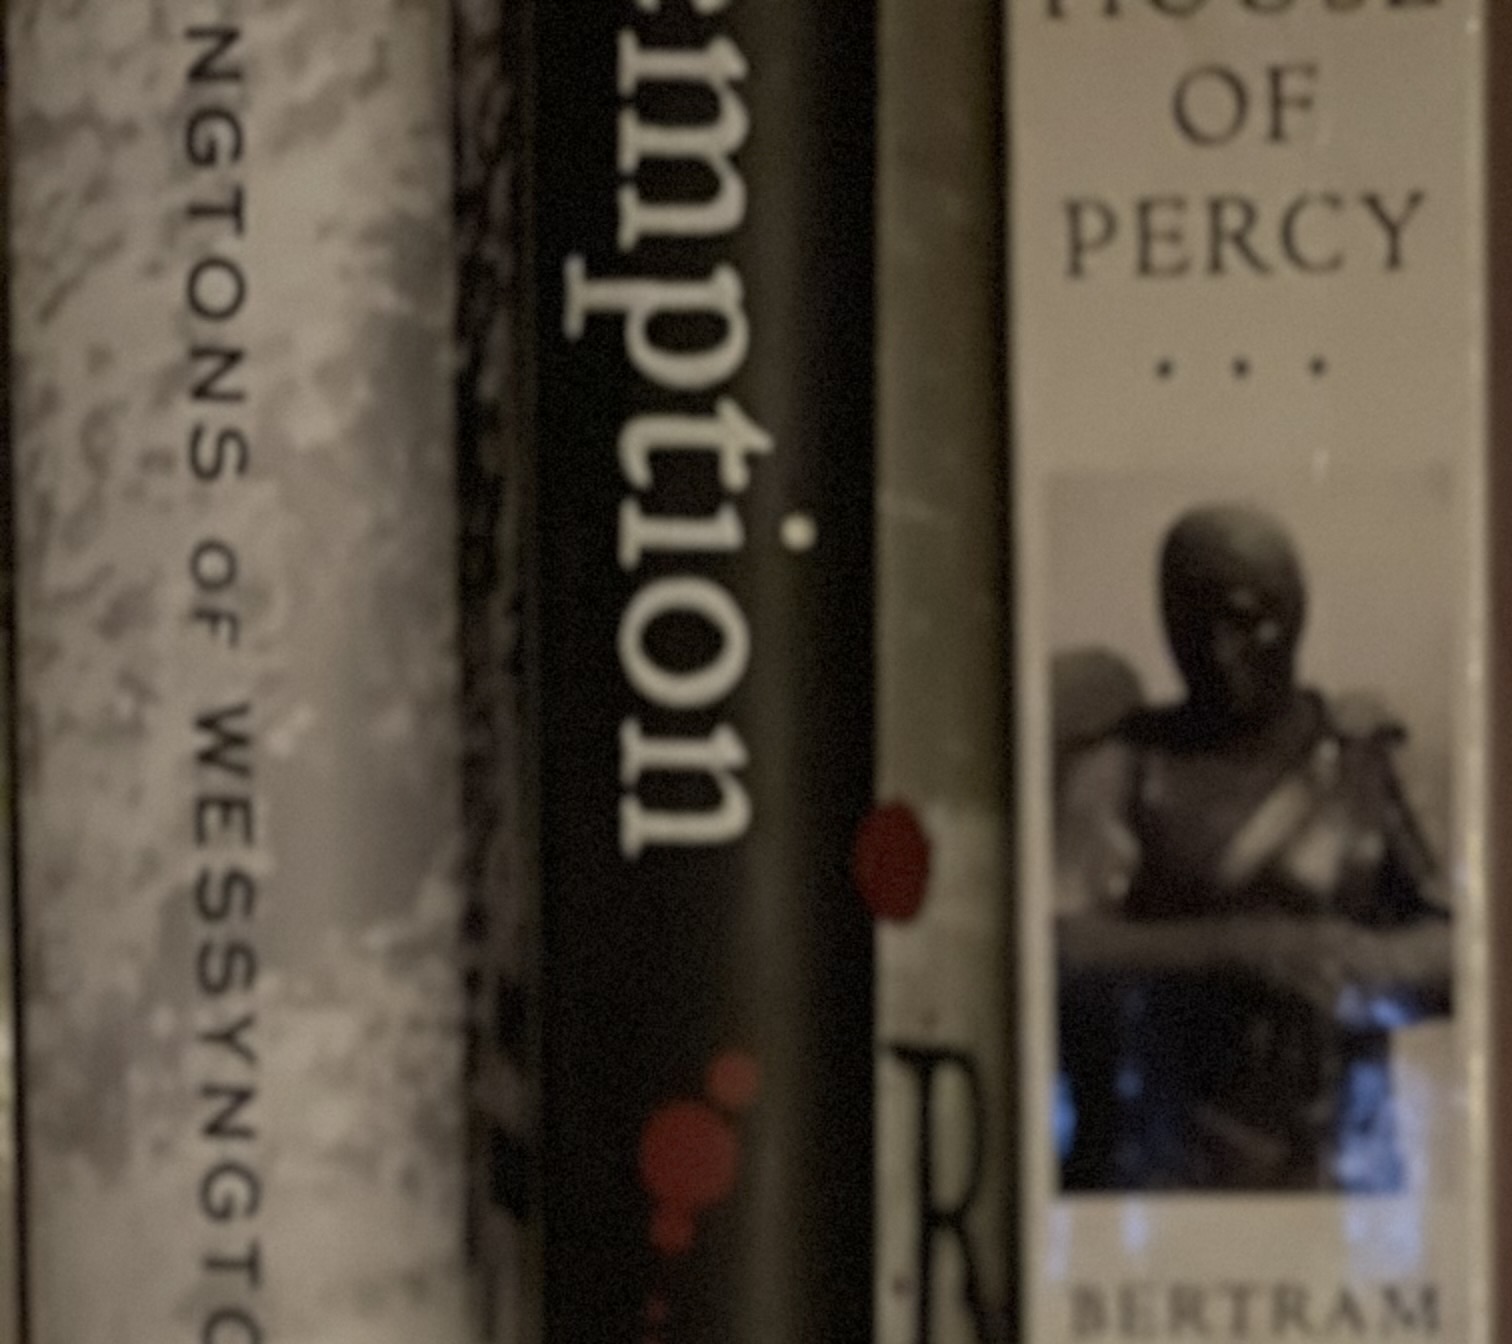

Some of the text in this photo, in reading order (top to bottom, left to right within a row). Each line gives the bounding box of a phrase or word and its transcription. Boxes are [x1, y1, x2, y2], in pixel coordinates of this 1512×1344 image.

[1171, 62, 1321, 147] OF
[184, 24, 249, 484] NGTONS
[1062, 190, 1426, 281] PERCY
[563, 0, 815, 858] mption
[187, 541, 239, 647] OF
[1067, 1281, 1442, 1342] BERTRAM
